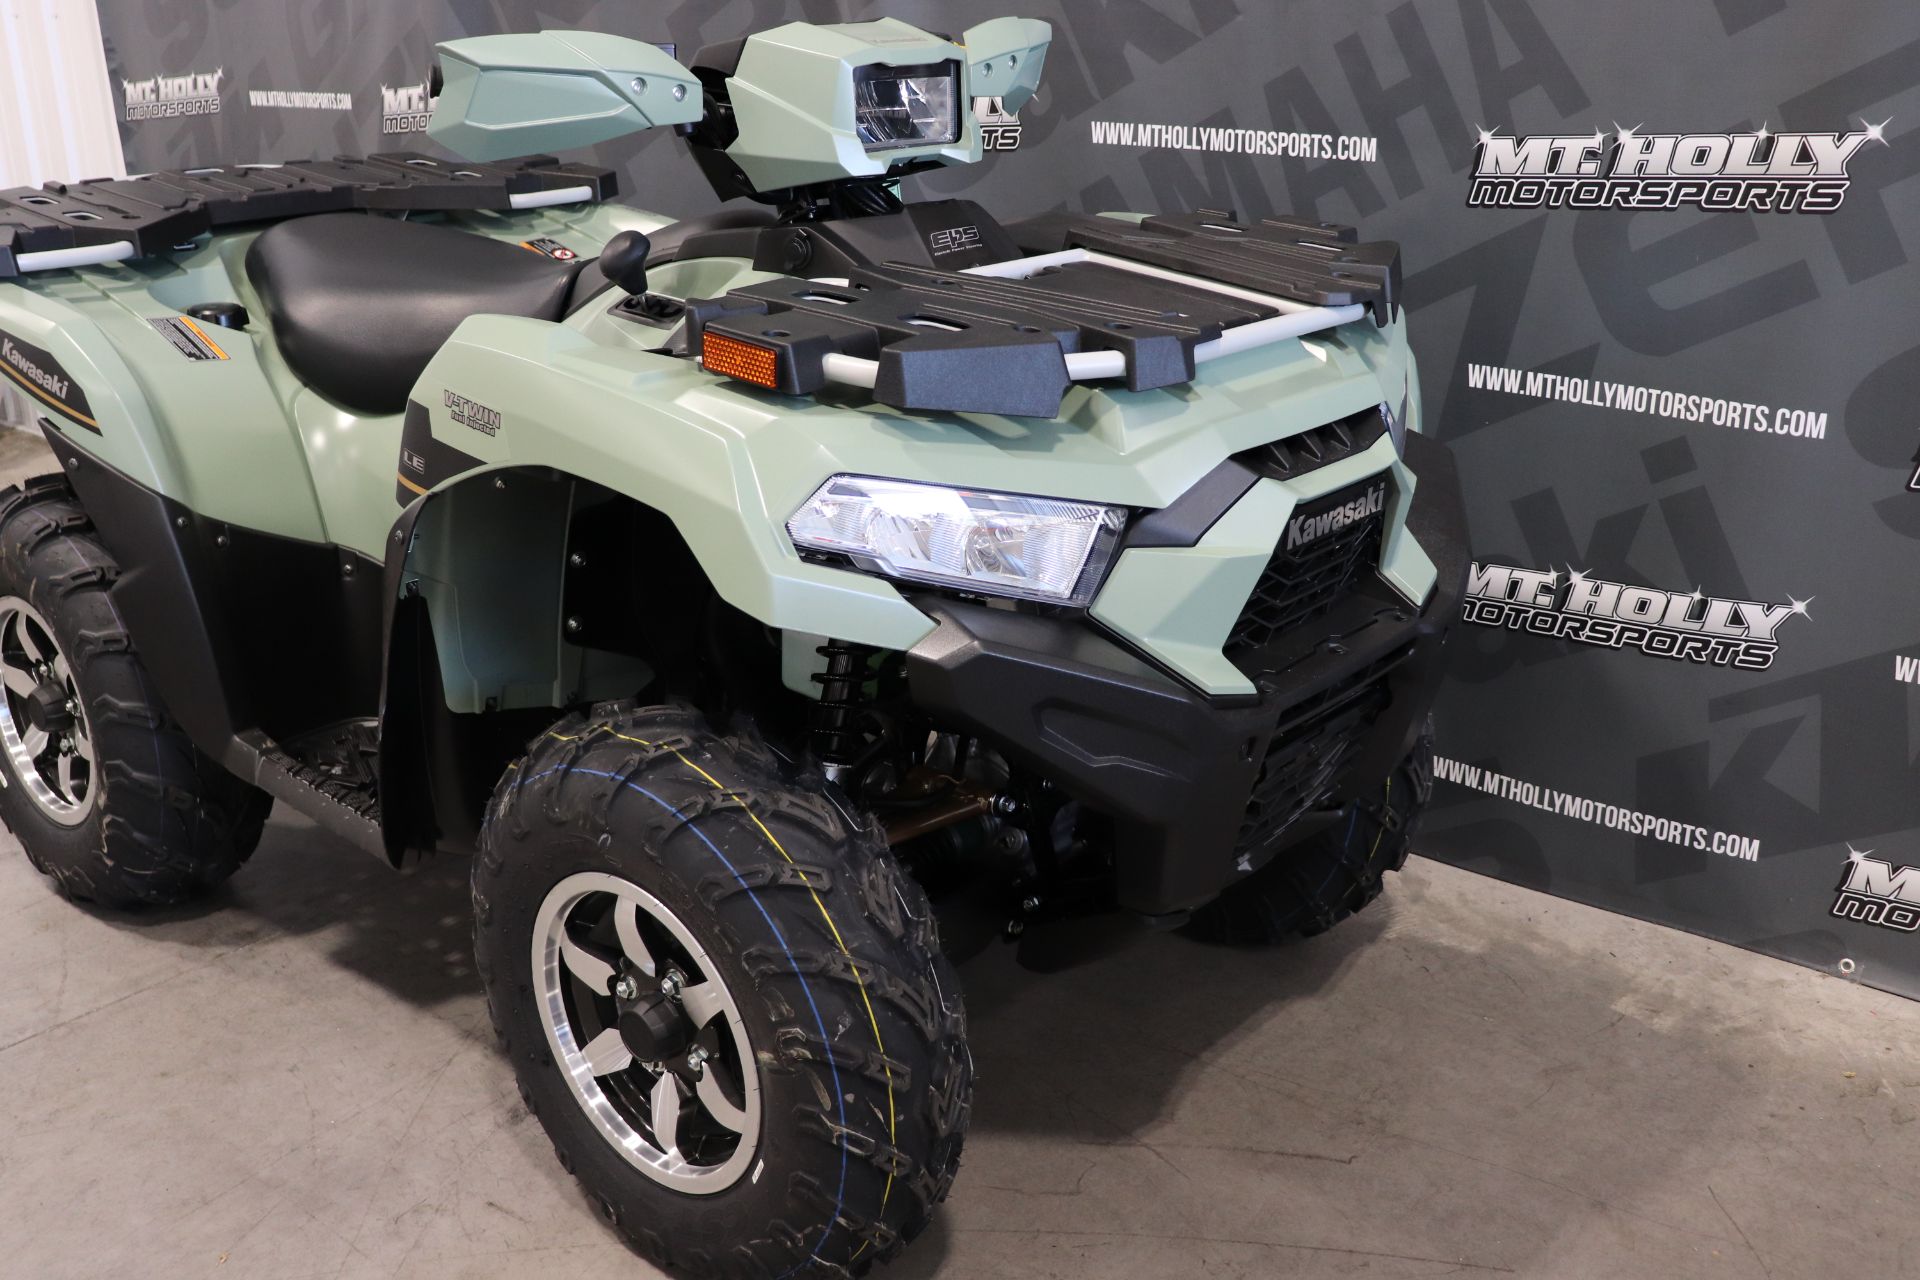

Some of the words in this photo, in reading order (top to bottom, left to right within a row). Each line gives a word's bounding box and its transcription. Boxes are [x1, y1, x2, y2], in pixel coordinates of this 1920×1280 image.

[159, 73, 219, 101] HOLLY
[249, 90, 352, 110] WWW.MTHOLLYMOTORSPORTS.COM
[126, 97, 220, 121] MOTORSPORTS
[1091, 121, 1377, 162] WWW.MTHOLLYMOTORSPORTS.COM
[1475, 134, 1602, 177] MT.
[1610, 133, 1868, 177] HOLLY
[1468, 179, 1851, 211] MOTORSPORTS
[931, 226, 980, 248] EPS
[2, 338, 69, 400] Kawasaki
[444, 389, 501, 429] V-TWIN
[1468, 363, 1828, 440] WWW.MTHOLLYMOTORSPORTS.COM
[451, 410, 465, 424] Fuel
[466, 416, 496, 437] Injected
[403, 449, 425, 475] LE
[1287, 482, 1386, 551] Kawasaki
[1564, 578, 1796, 643] HOLLY
[1433, 755, 1761, 862] WWW.MTHOLLYMOTORSPORTS.COM
